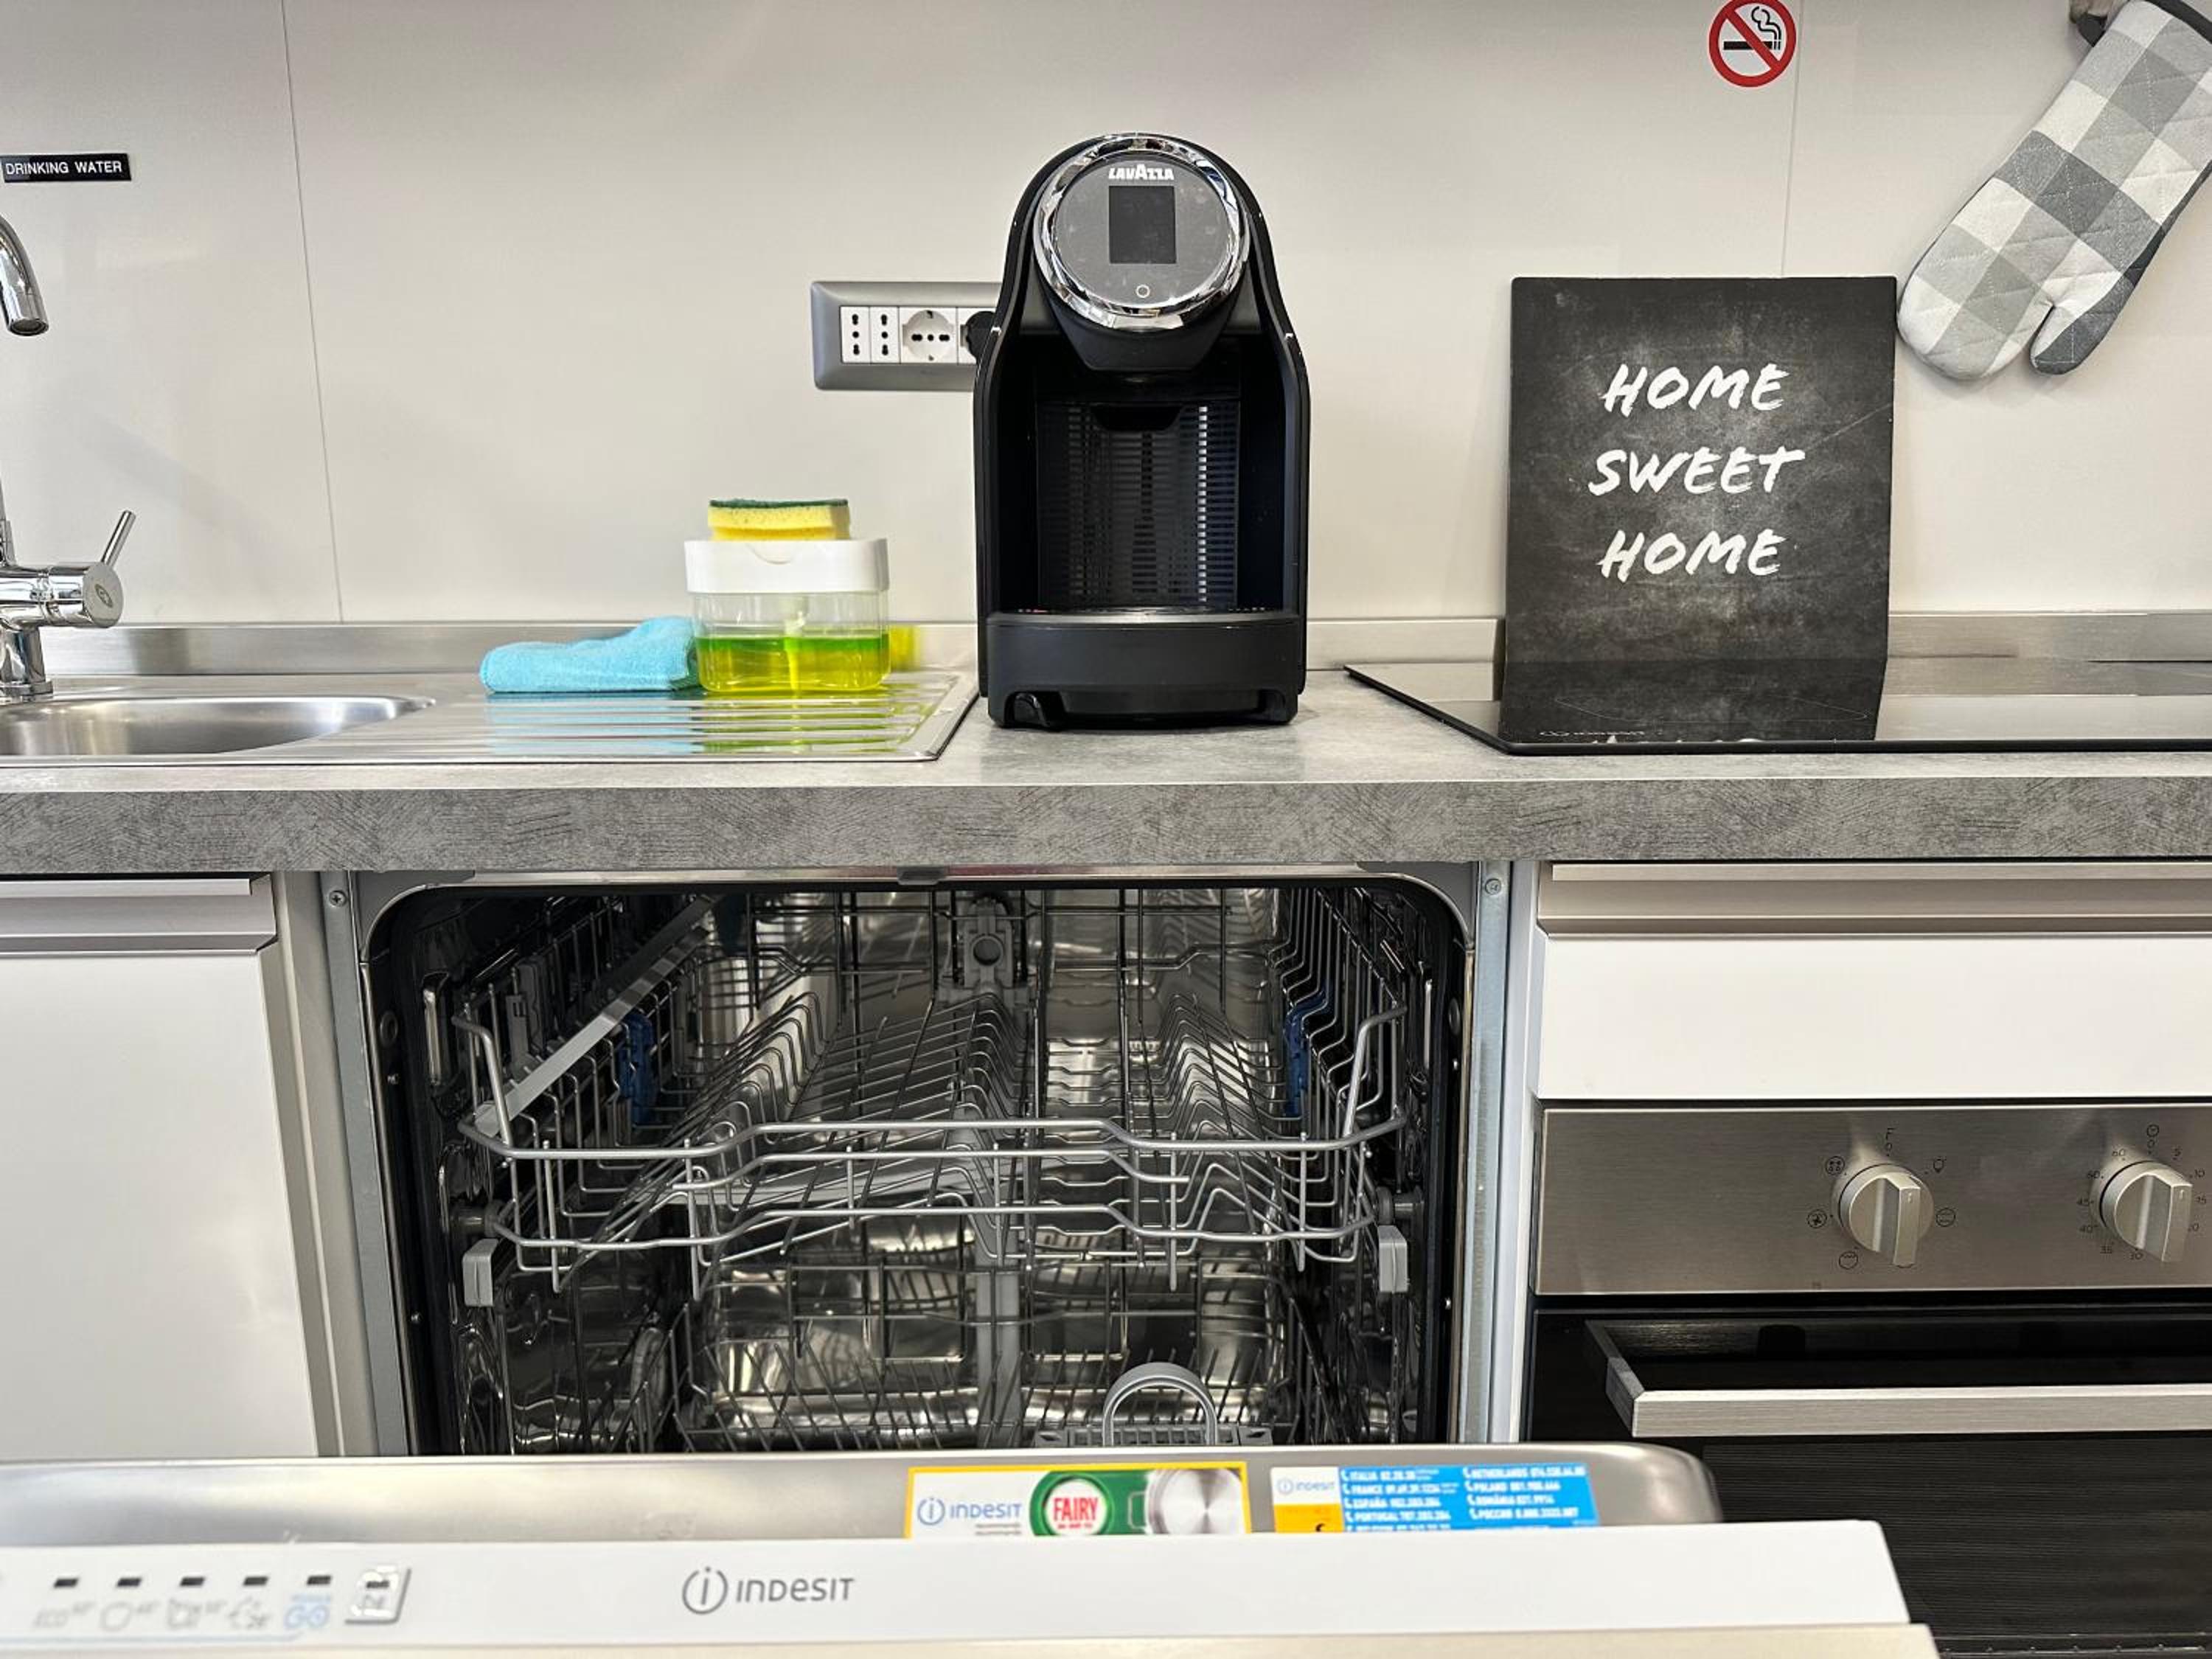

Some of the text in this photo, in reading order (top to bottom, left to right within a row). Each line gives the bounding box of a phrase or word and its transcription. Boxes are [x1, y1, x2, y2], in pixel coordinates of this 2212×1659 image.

[5, 161, 122, 175] DRINKING WATER
[1108, 164, 1175, 181] LAVAZZA
[1599, 364, 1790, 417] HOME
[1588, 445, 1806, 496] SWEET
[1596, 529, 1787, 582] HOME
[950, 1503, 1022, 1518] INDESIT
[1054, 1497, 1099, 1521] FAIRY
[736, 1577, 854, 1603] INDESIT
